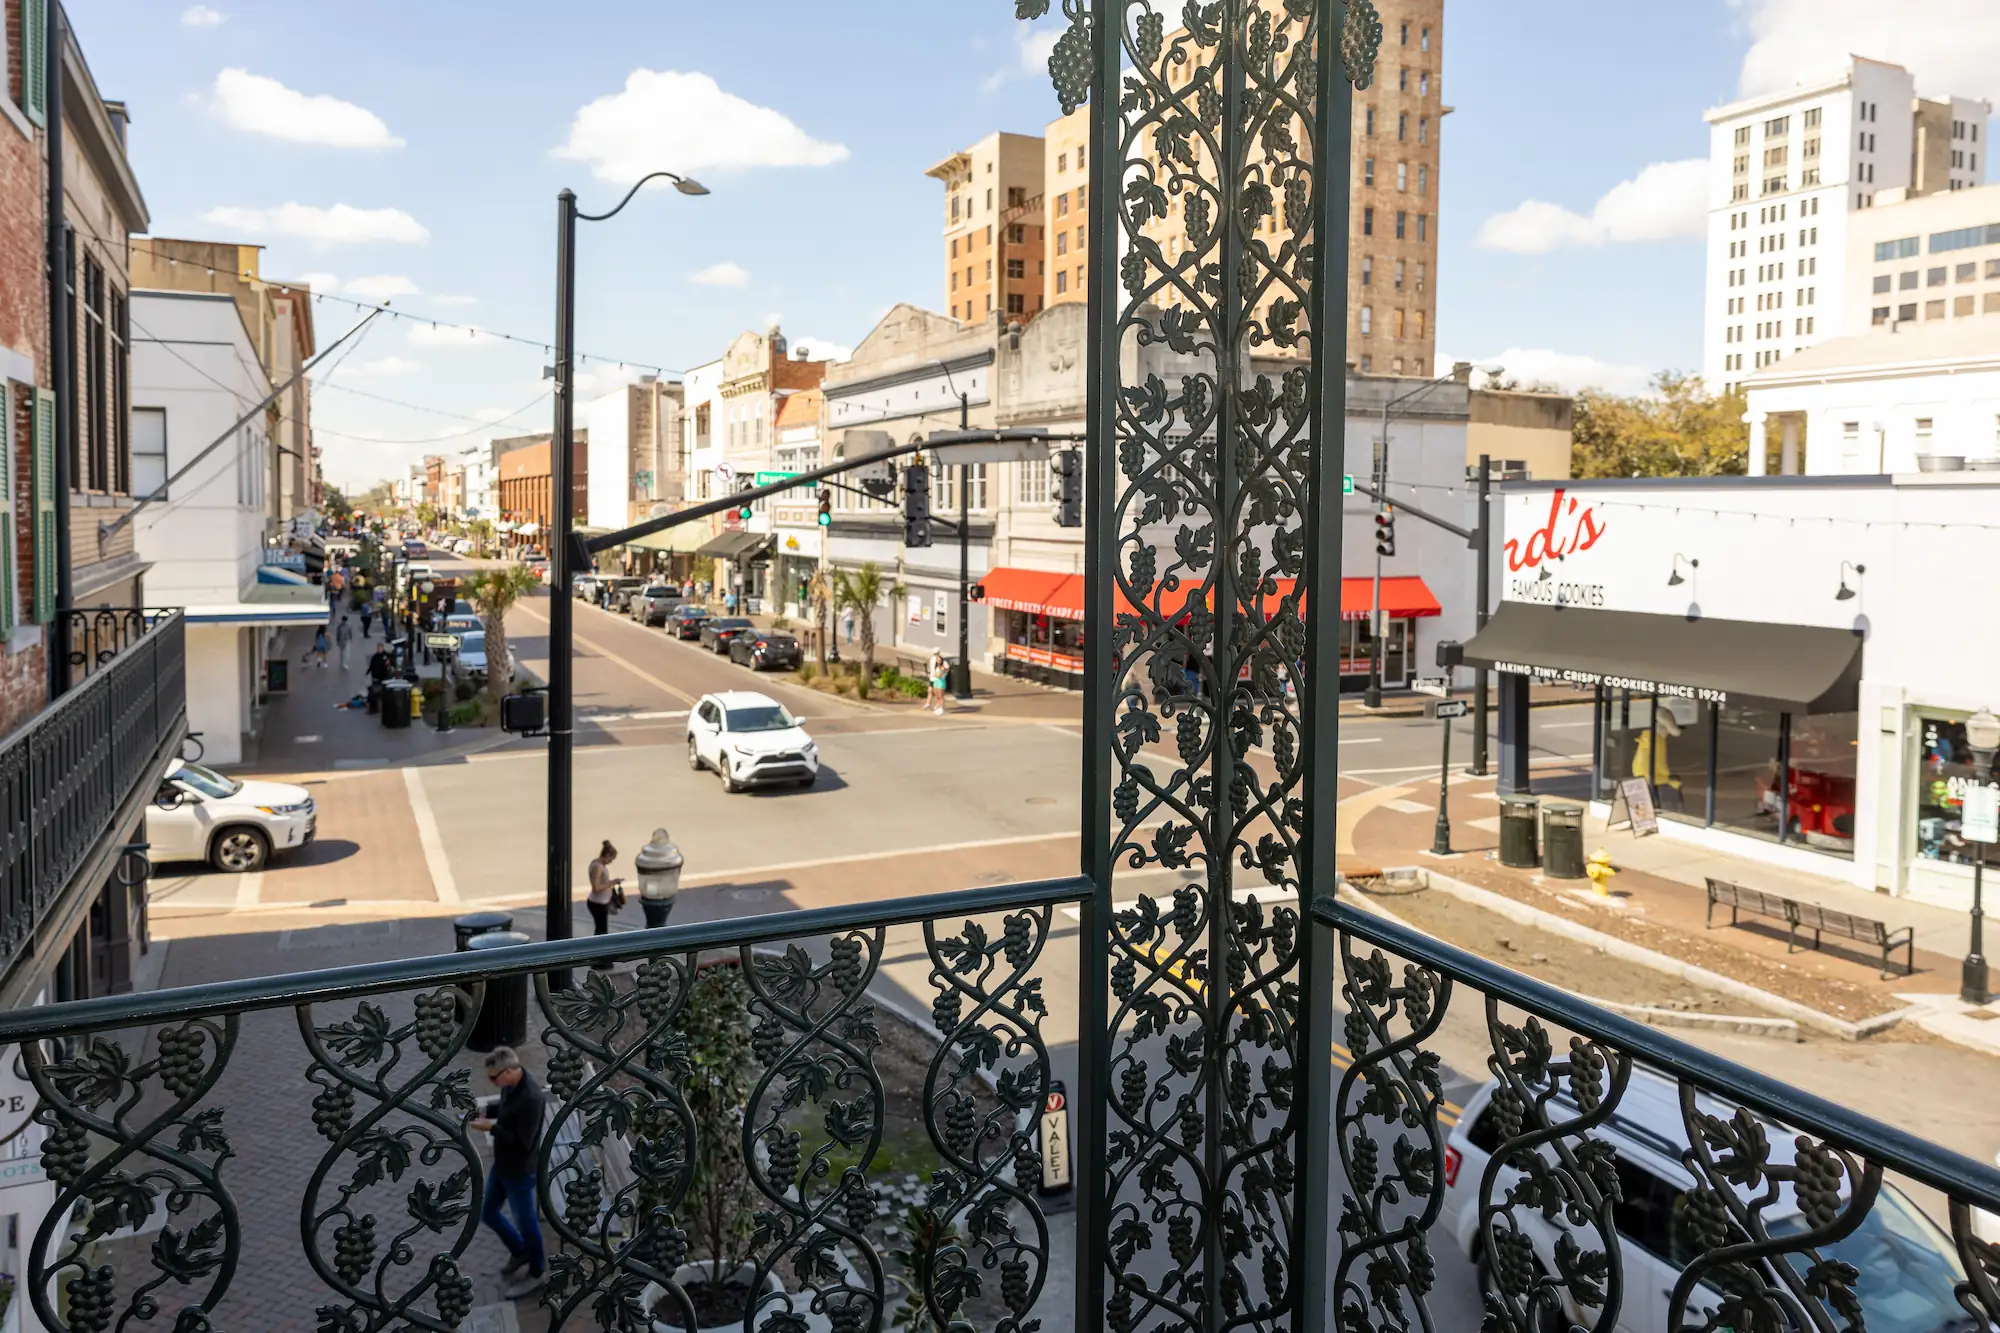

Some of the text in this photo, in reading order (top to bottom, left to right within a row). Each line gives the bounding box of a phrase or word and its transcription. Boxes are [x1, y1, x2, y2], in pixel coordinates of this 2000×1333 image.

[1512, 579, 1604, 606] FAMOUS COOKIES
[1495, 661, 1531, 676] BAKING
[1563, 670, 1601, 685] CRISPY
[1603, 675, 1655, 693] COOKIES
[1658, 683, 1695, 698] SINCE
[1698, 688, 1727, 703] 1924
[1048, 1116, 1061, 1180] VALET
[0, 1164, 41, 1178] OTS
